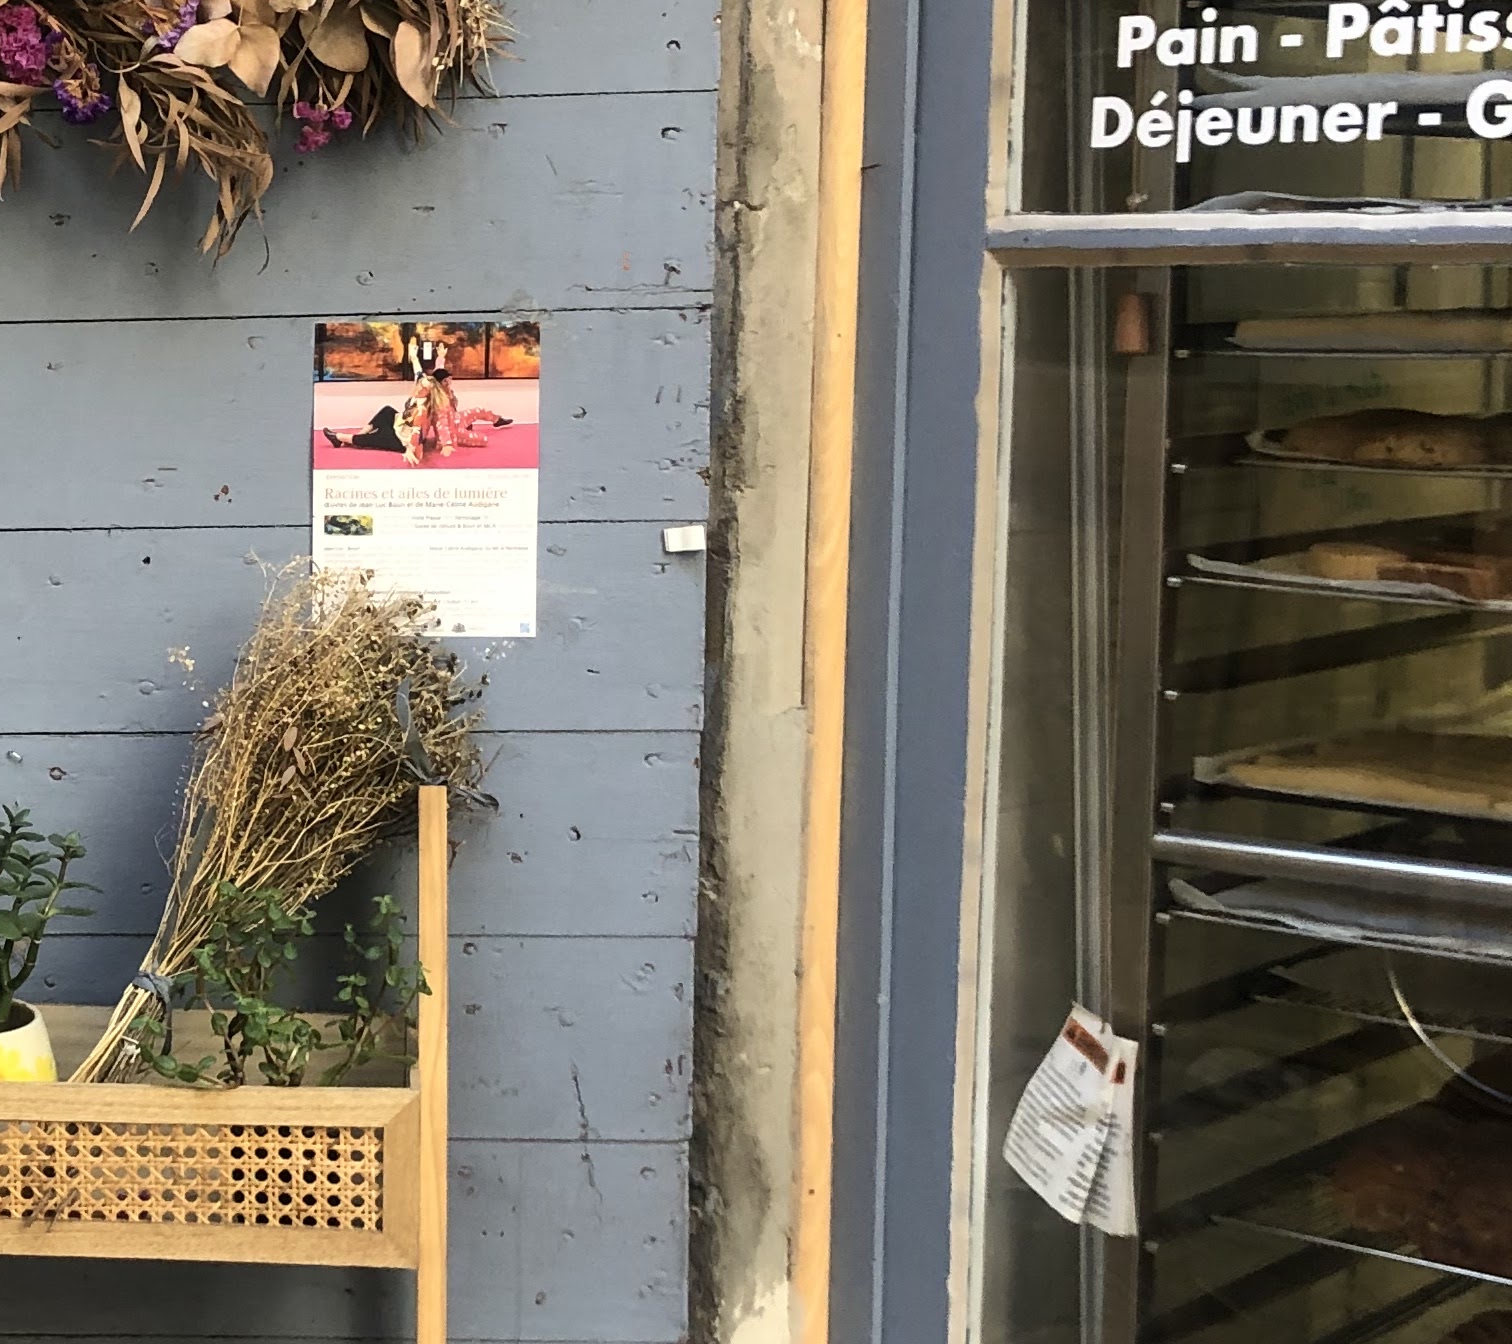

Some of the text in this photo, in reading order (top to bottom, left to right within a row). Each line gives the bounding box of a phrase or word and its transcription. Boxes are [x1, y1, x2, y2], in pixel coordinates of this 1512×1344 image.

[1116, 7, 1259, 69] Pain
[1279, 34, 1304, 48] -
[1090, 89, 1399, 164] Déjeuner
[1417, 112, 1443, 126] -
[324, 486, 508, 500] Racines et ailes de lumière
